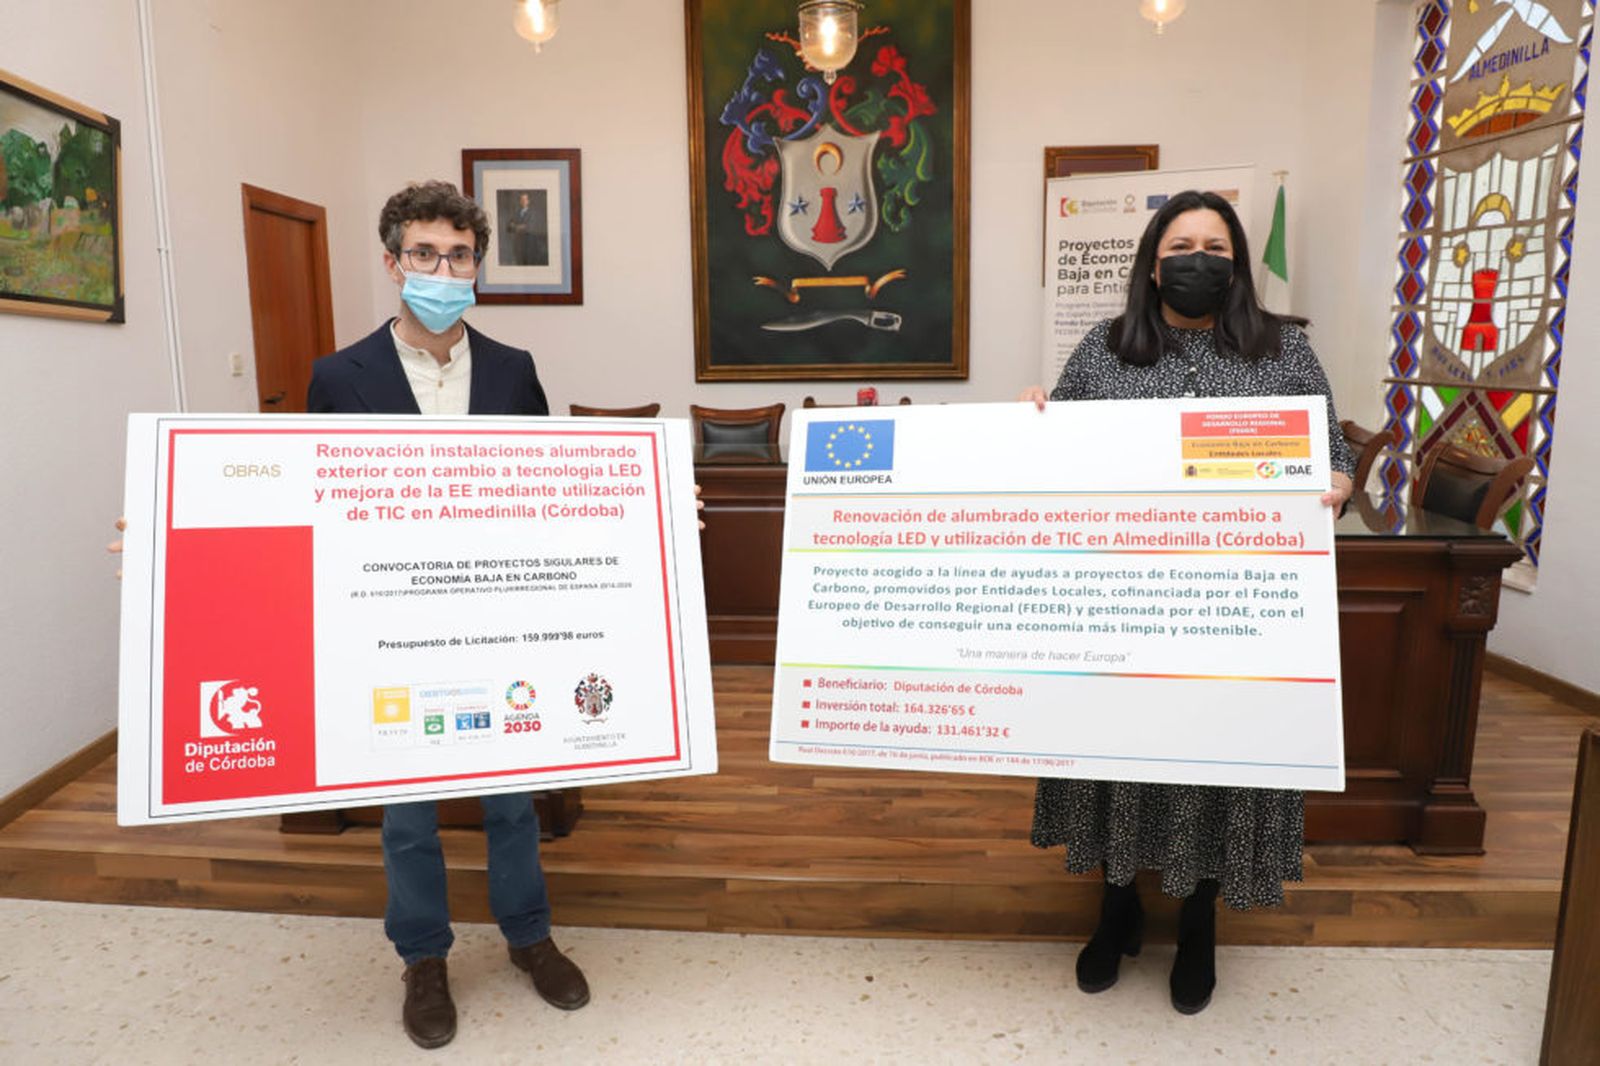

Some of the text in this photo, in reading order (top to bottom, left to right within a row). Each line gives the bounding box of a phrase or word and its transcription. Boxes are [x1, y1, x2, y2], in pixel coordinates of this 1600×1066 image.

[1470, 36, 1550, 81] ALMEDINILLA
[1059, 239, 1134, 254] Proyectos
[1058, 254, 1076, 264] de
[1058, 267, 1089, 281] Baja
[1094, 269, 1112, 278] en
[1057, 285, 1088, 296] para
[316, 444, 636, 457] Renovación instalaciones alumbrado
[223, 464, 280, 476] OBRAS
[316, 465, 387, 477] exterior
[393, 467, 425, 477] con
[432, 464, 496, 476] cambio
[502, 467, 510, 476] a
[608, 463, 641, 476] LED
[1284, 465, 1312, 475] IDAE
[803, 475, 892, 484] UNIÓN EUROPEA
[314, 483, 644, 502] y mejora de la EE mediante utilización
[346, 504, 624, 520] de TIC en Almedinilla (Córdoba)
[833, 508, 1280, 522] Renovación de alumbrado exterior mediante cambio a
[813, 531, 1304, 548] tecnología LED y utilización de TIC en Almedinilla (Córdoba)
[363, 561, 453, 571] CONVOCATORIA
[474, 559, 540, 567] PROYECTOS
[544, 557, 602, 566] SIGULARES
[411, 575, 470, 584] ECONOMÍA
[474, 574, 502, 582] BAJA
[523, 571, 576, 580] CARBONO
[813, 566, 868, 577] Proyecto
[872, 567, 922, 578] acogido
[938, 567, 948, 576] la
[954, 567, 985, 576] línea
[990, 567, 1006, 577] de
[1010, 568, 1058, 579] ayudas
[1074, 570, 1142, 580] proyectos
[1147, 568, 1164, 578] de
[1169, 569, 1238, 579] Economía
[1244, 569, 1274, 582] Baja
[812, 583, 1298, 599] Carbono, promovidos por Entidades Locales, cofinanciada por el Fondo
[808, 600, 1303, 617] Europeo de Desarrollo Regional (FEDER) y gestionada por el IDAE, con el
[842, 618, 894, 628] objetivo
[898, 618, 914, 628] de
[918, 620, 982, 631] conseguir
[1016, 622, 1083, 631] economía
[1088, 623, 1116, 632] más
[1121, 623, 1164, 635] limpia
[1170, 626, 1177, 636] y
[1182, 625, 1261, 635] sostenible.
[378, 639, 446, 648] Presupuesto
[464, 636, 518, 644] Licitación:
[985, 650, 1027, 659] manera
[1030, 650, 1045, 660] de
[1048, 651, 1080, 660] hacer
[818, 677, 1022, 694] Beneficiario: Diputación de Córdoba
[816, 700, 866, 710] Inversión
[869, 702, 898, 712] total:
[968, 705, 974, 715] €
[504, 712, 540, 721] AGENDA
[504, 720, 542, 734] 2030
[815, 719, 860, 730] Importe
[862, 720, 877, 731] de
[880, 721, 889, 731] la
[892, 723, 930, 734] ayuda:
[1002, 727, 1008, 737] €
[185, 738, 275, 758] Diputación
[185, 755, 274, 772] de Córdoba
